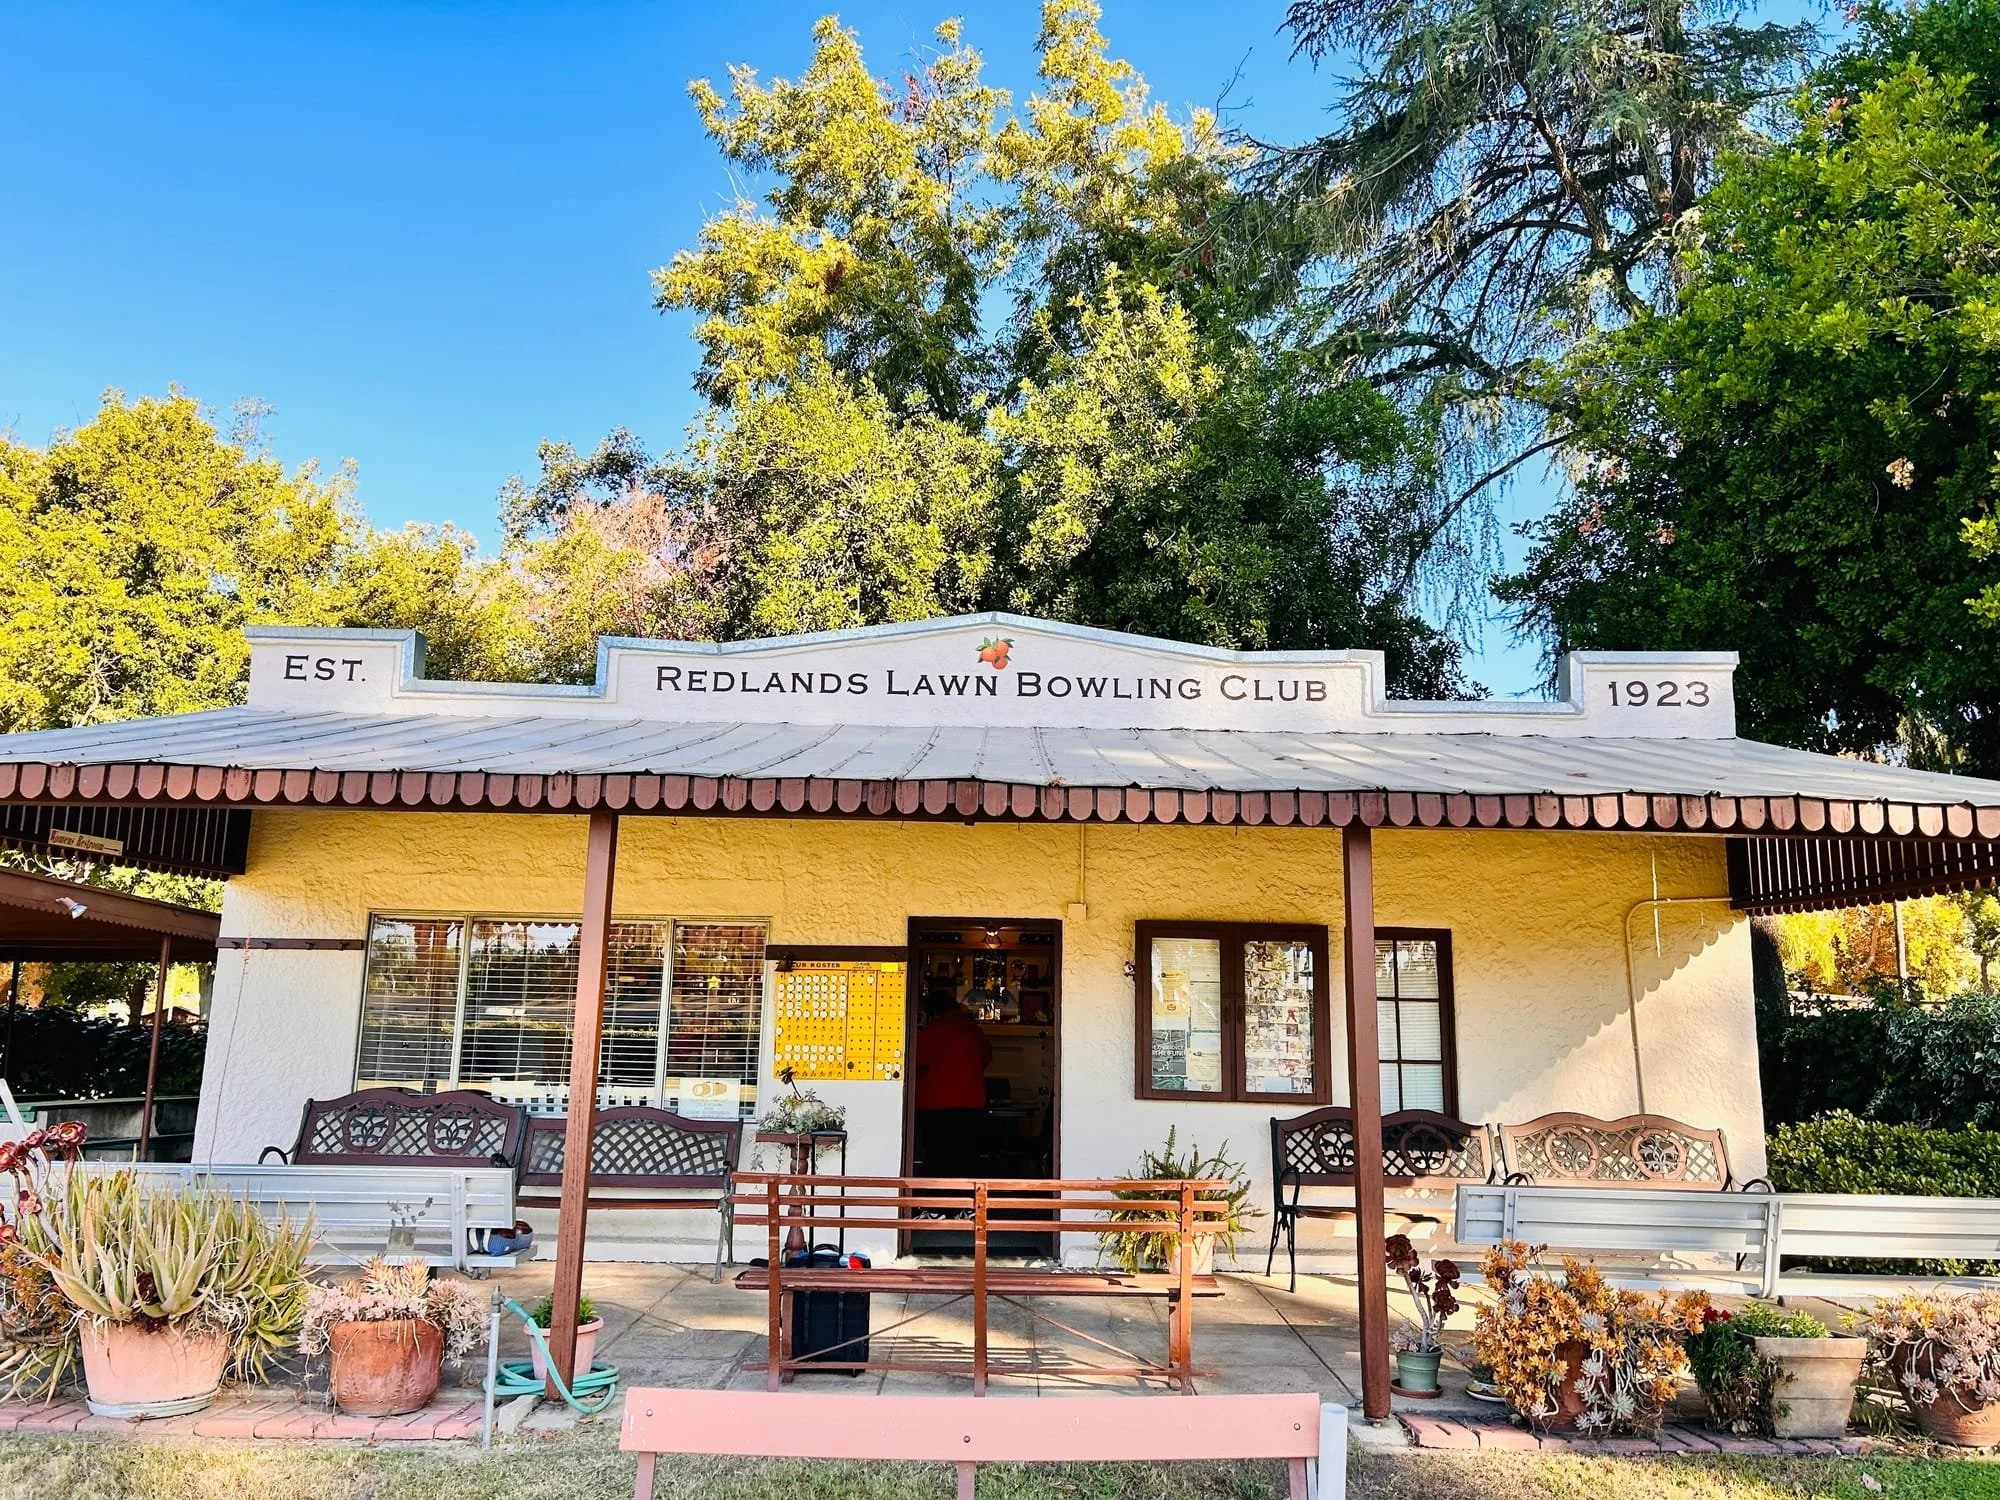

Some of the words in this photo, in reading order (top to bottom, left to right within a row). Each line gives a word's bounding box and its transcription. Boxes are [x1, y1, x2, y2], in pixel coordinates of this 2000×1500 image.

[284, 654, 366, 682] EST.
[656, 666, 868, 695] REDLANDS
[886, 669, 998, 697] LAWN
[1016, 672, 1202, 701] BOWLING
[1220, 674, 1327, 702] CLUB
[1608, 680, 1710, 708] 1923
